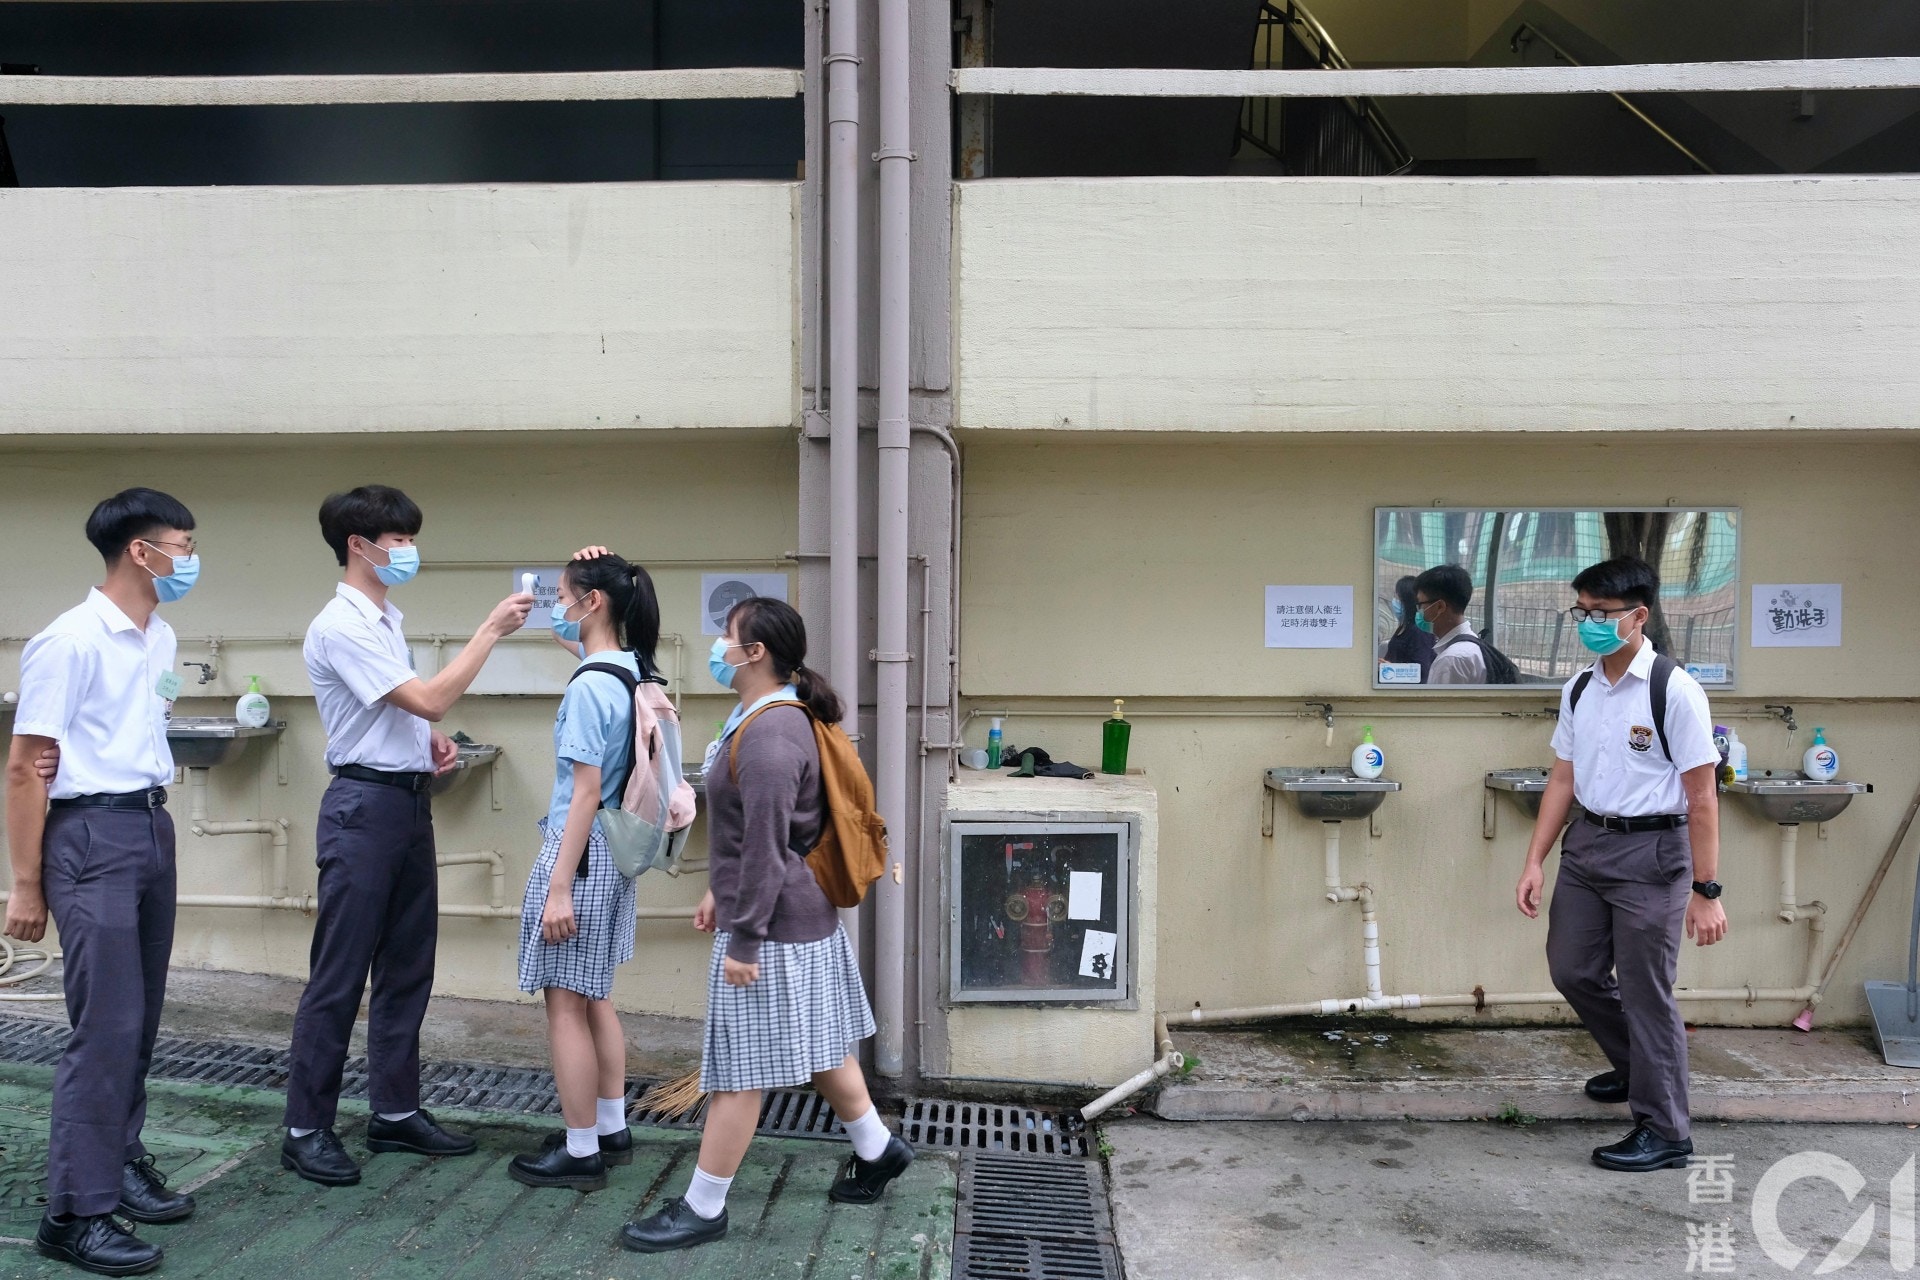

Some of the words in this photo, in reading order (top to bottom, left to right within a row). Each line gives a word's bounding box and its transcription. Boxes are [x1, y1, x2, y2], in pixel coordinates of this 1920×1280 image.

[1276, 605, 1342, 615] 請注意個人衛生
[1280, 618, 1338, 628] 定時消毒雙手
[1769, 608, 1825, 631] 勤洗手
